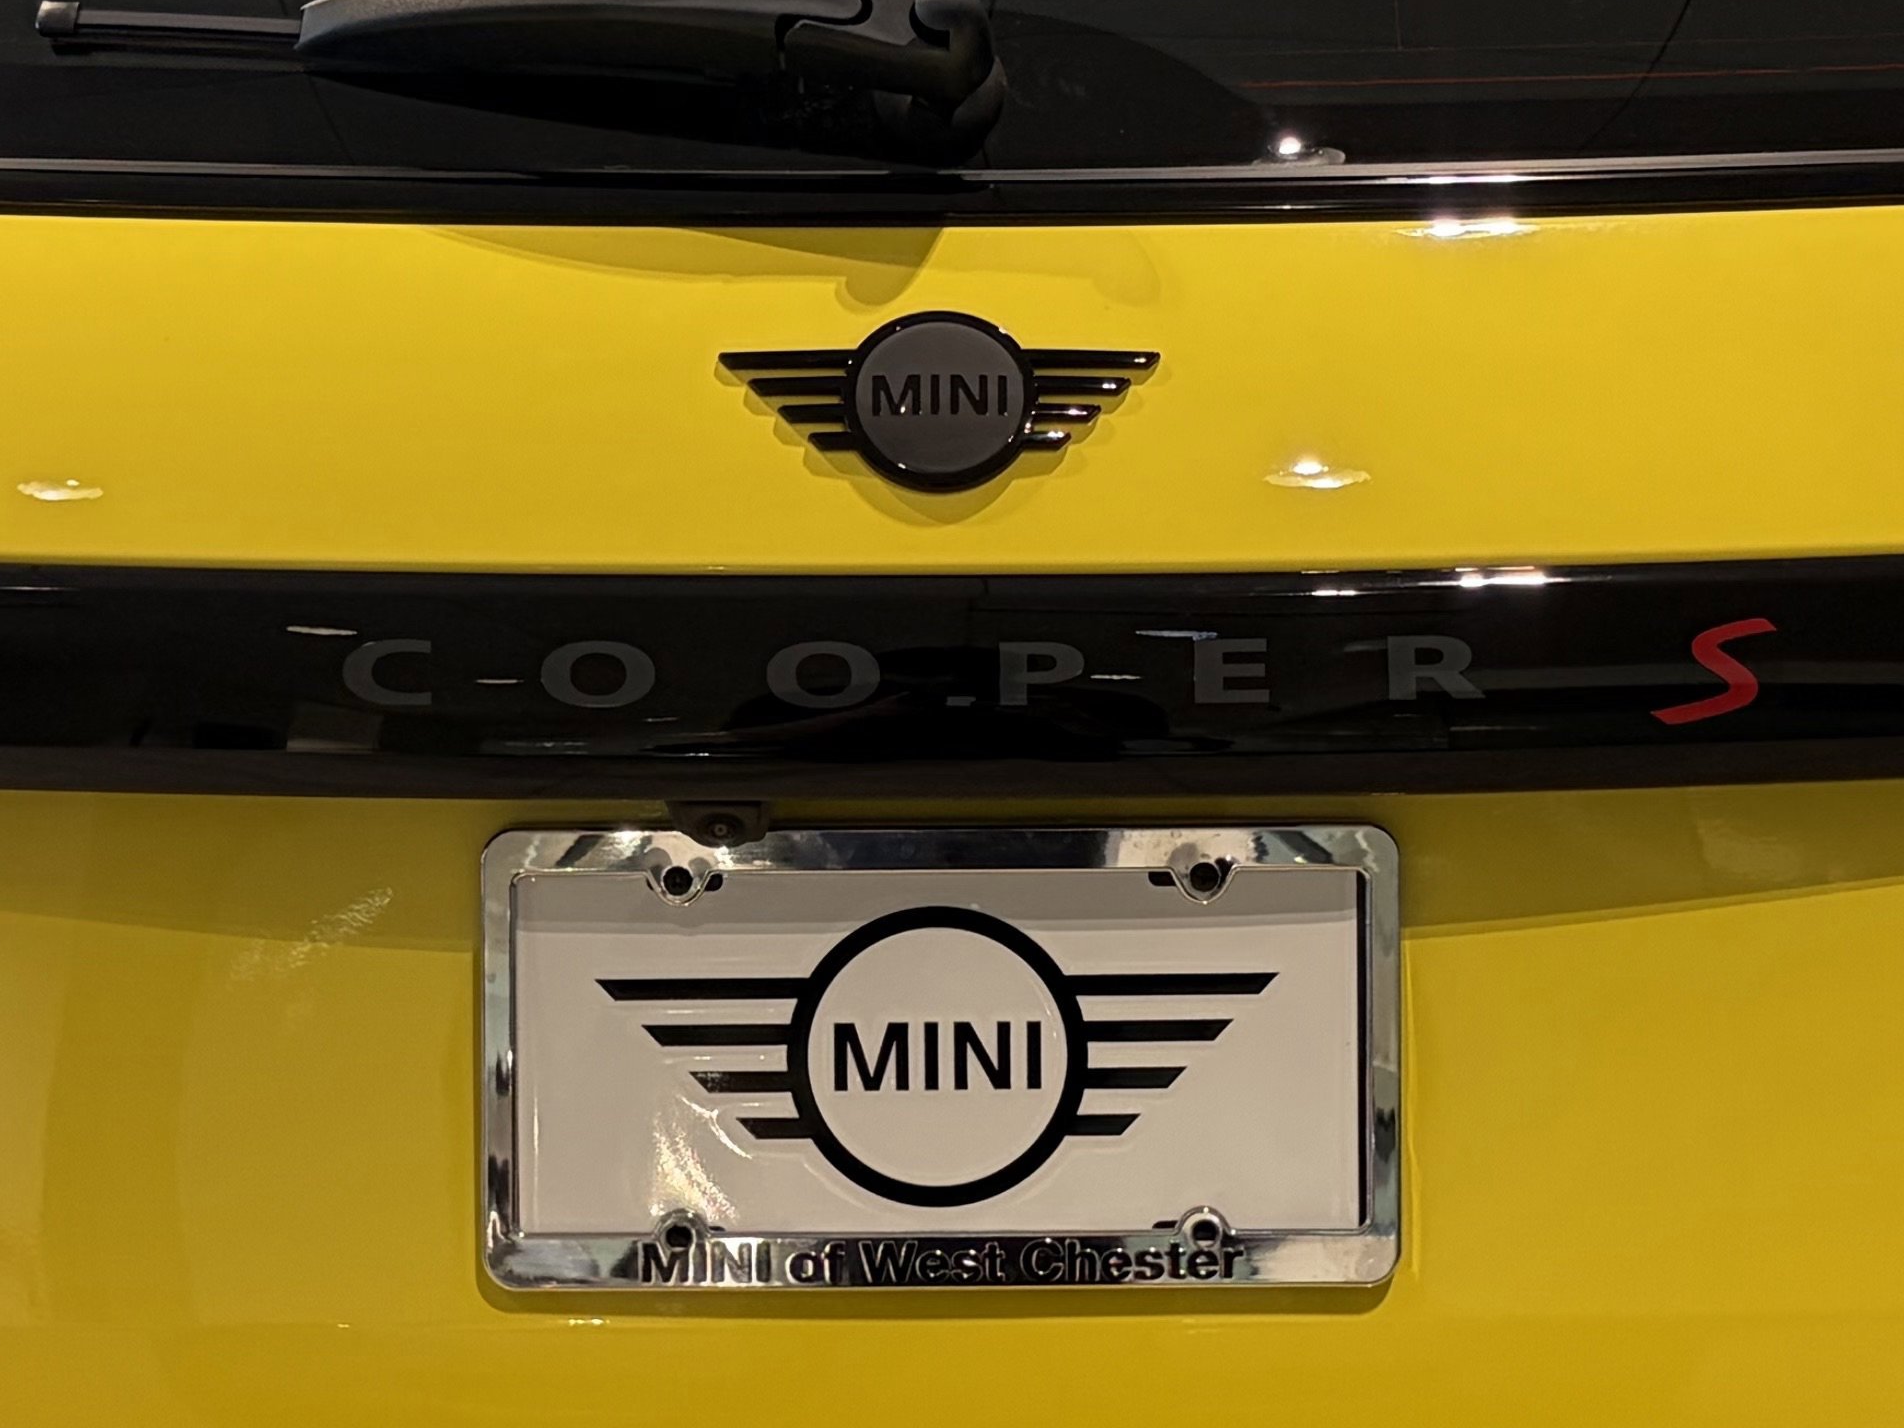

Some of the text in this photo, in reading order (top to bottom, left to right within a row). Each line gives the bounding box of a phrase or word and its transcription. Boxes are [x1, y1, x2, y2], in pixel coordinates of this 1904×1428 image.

[872, 374, 1008, 416] MINI
[342, 617, 1777, 725] COOPER S
[832, 1020, 1044, 1092] MINI
[640, 1237, 1246, 1285] MINI of West Chester
